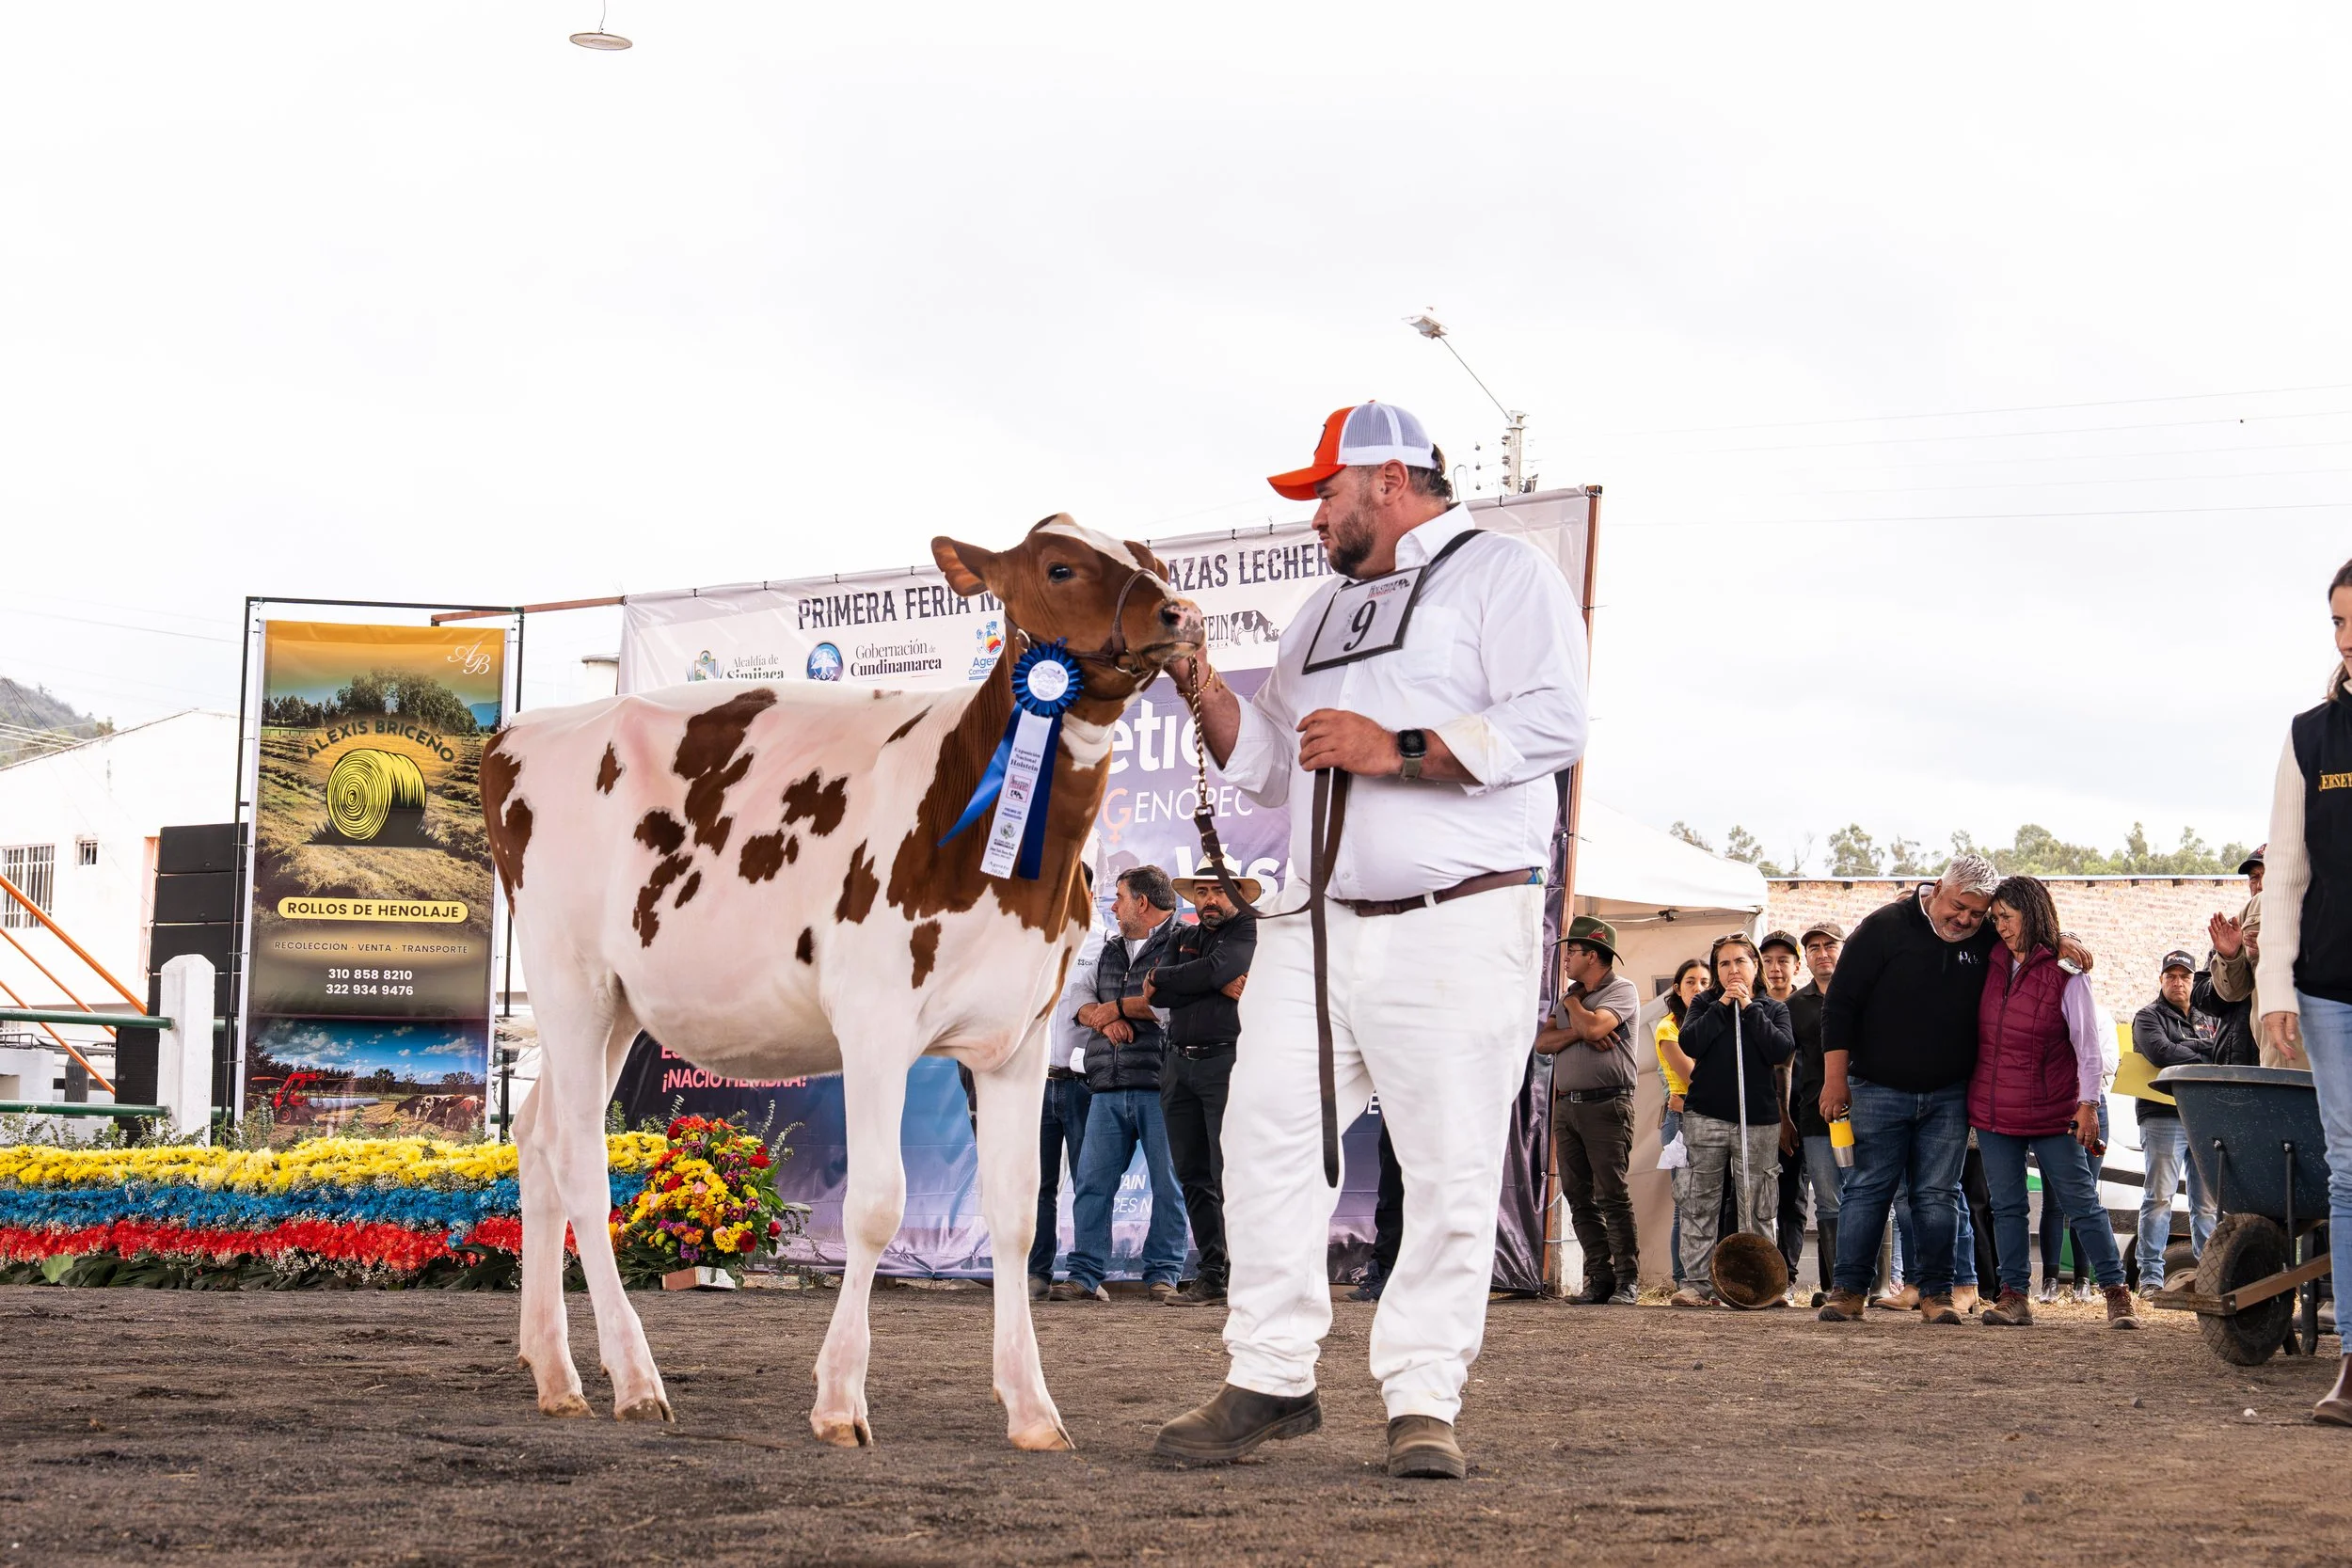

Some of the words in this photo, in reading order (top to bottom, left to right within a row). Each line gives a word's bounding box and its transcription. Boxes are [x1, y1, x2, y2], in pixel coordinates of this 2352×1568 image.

[798, 590, 898, 630] PRIMERA
[905, 584, 972, 620] FERIA
[1343, 600, 1376, 652] 9
[855, 638, 928, 659] Gobernación
[733, 654, 767, 669] Alcaldía
[769, 654, 779, 665] de
[850, 657, 942, 676] Cundinamarca
[305, 721, 368, 758] ALEXIS
[374, 719, 454, 762] BRICEÑO
[1010, 759, 1039, 772] Holstein
[287, 902, 348, 916] ROLLOS
[353, 903, 373, 916] DE
[377, 904, 460, 919] HENOLAJE
[274, 940, 349, 951] RECOLECCIÓN
[358, 943, 392, 952] VENTA
[402, 944, 469, 954] TRANSPORTE
[328, 968, 350, 979] 310
[354, 969, 379, 980] 858
[383, 969, 413, 980] 8210
[326, 984, 349, 994] 322
[353, 984, 377, 995] 934
[381, 985, 414, 996] 9476
